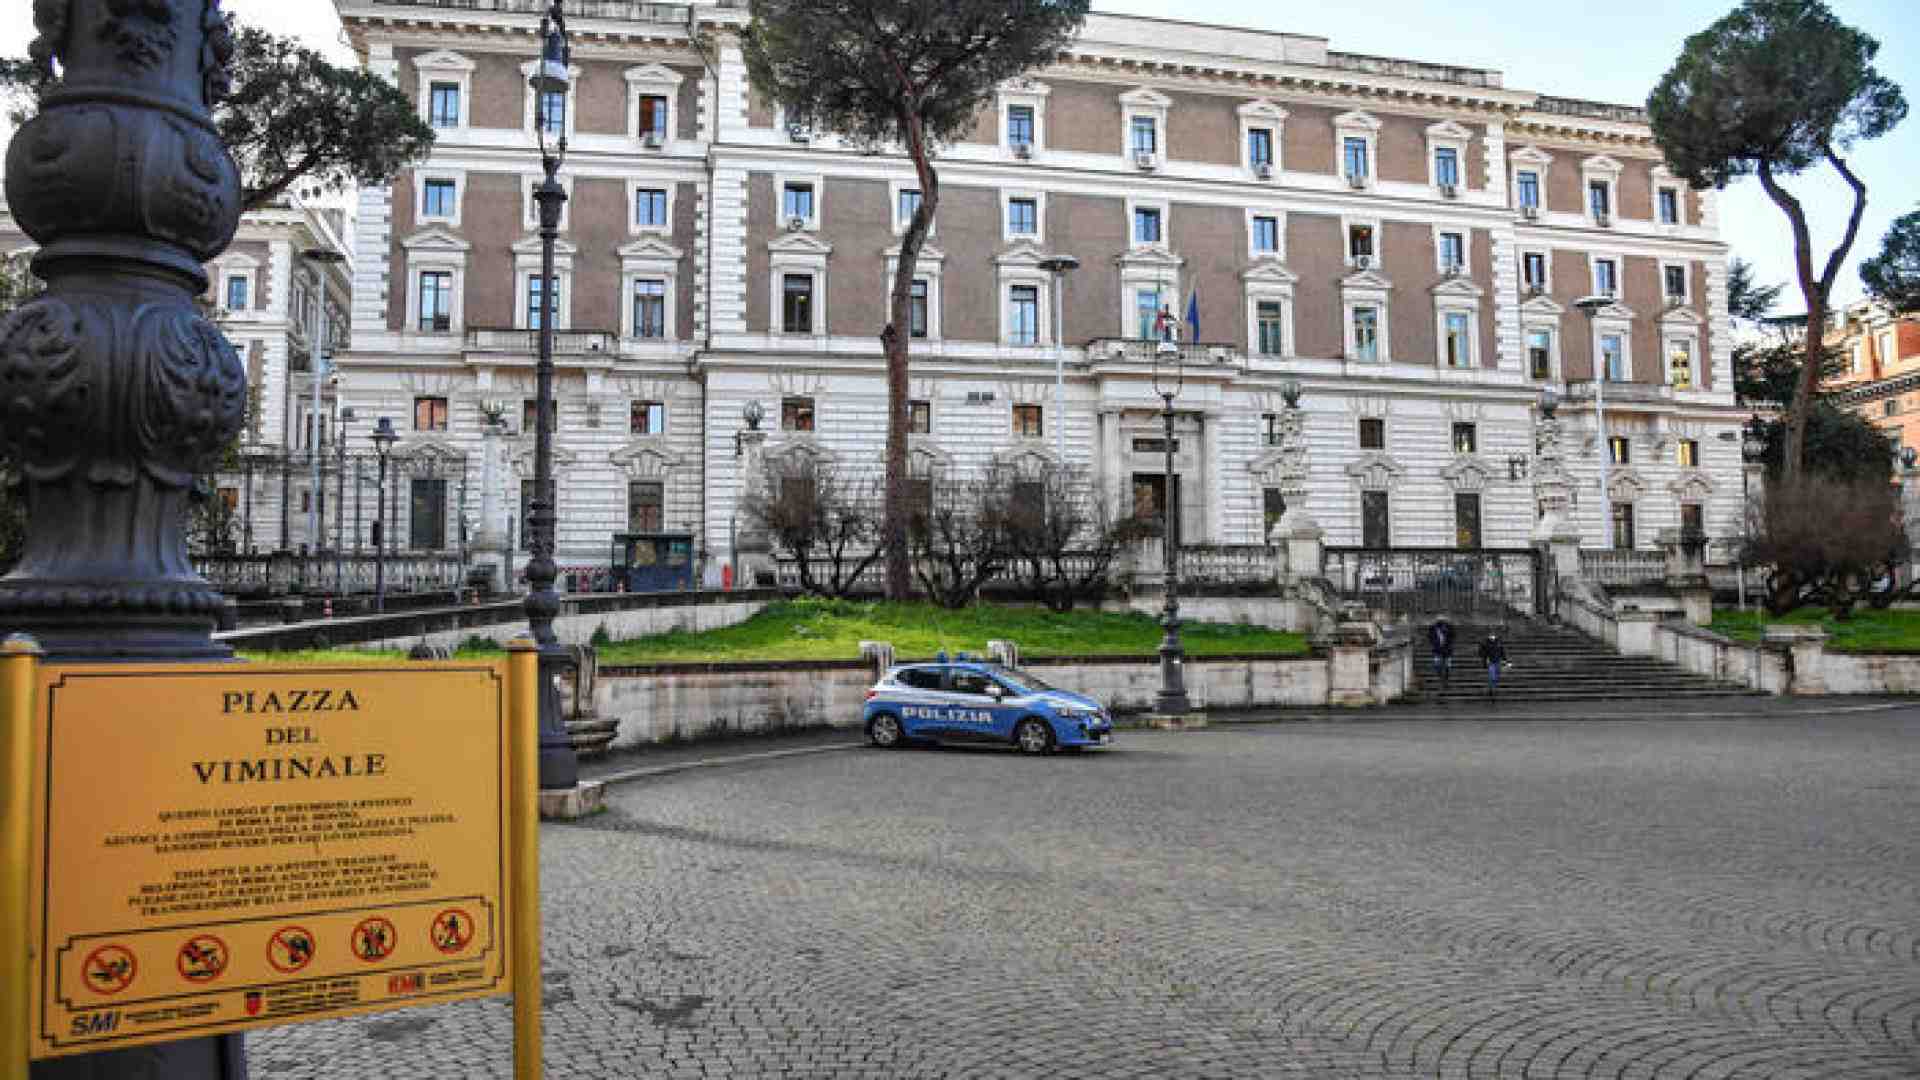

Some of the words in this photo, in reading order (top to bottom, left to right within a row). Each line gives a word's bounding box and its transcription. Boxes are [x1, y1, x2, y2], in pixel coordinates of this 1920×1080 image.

[222, 689, 360, 713] PIAZZA
[902, 706, 993, 723] POLIZIA
[265, 727, 319, 745] DEL
[192, 754, 386, 784] VIMINALE
